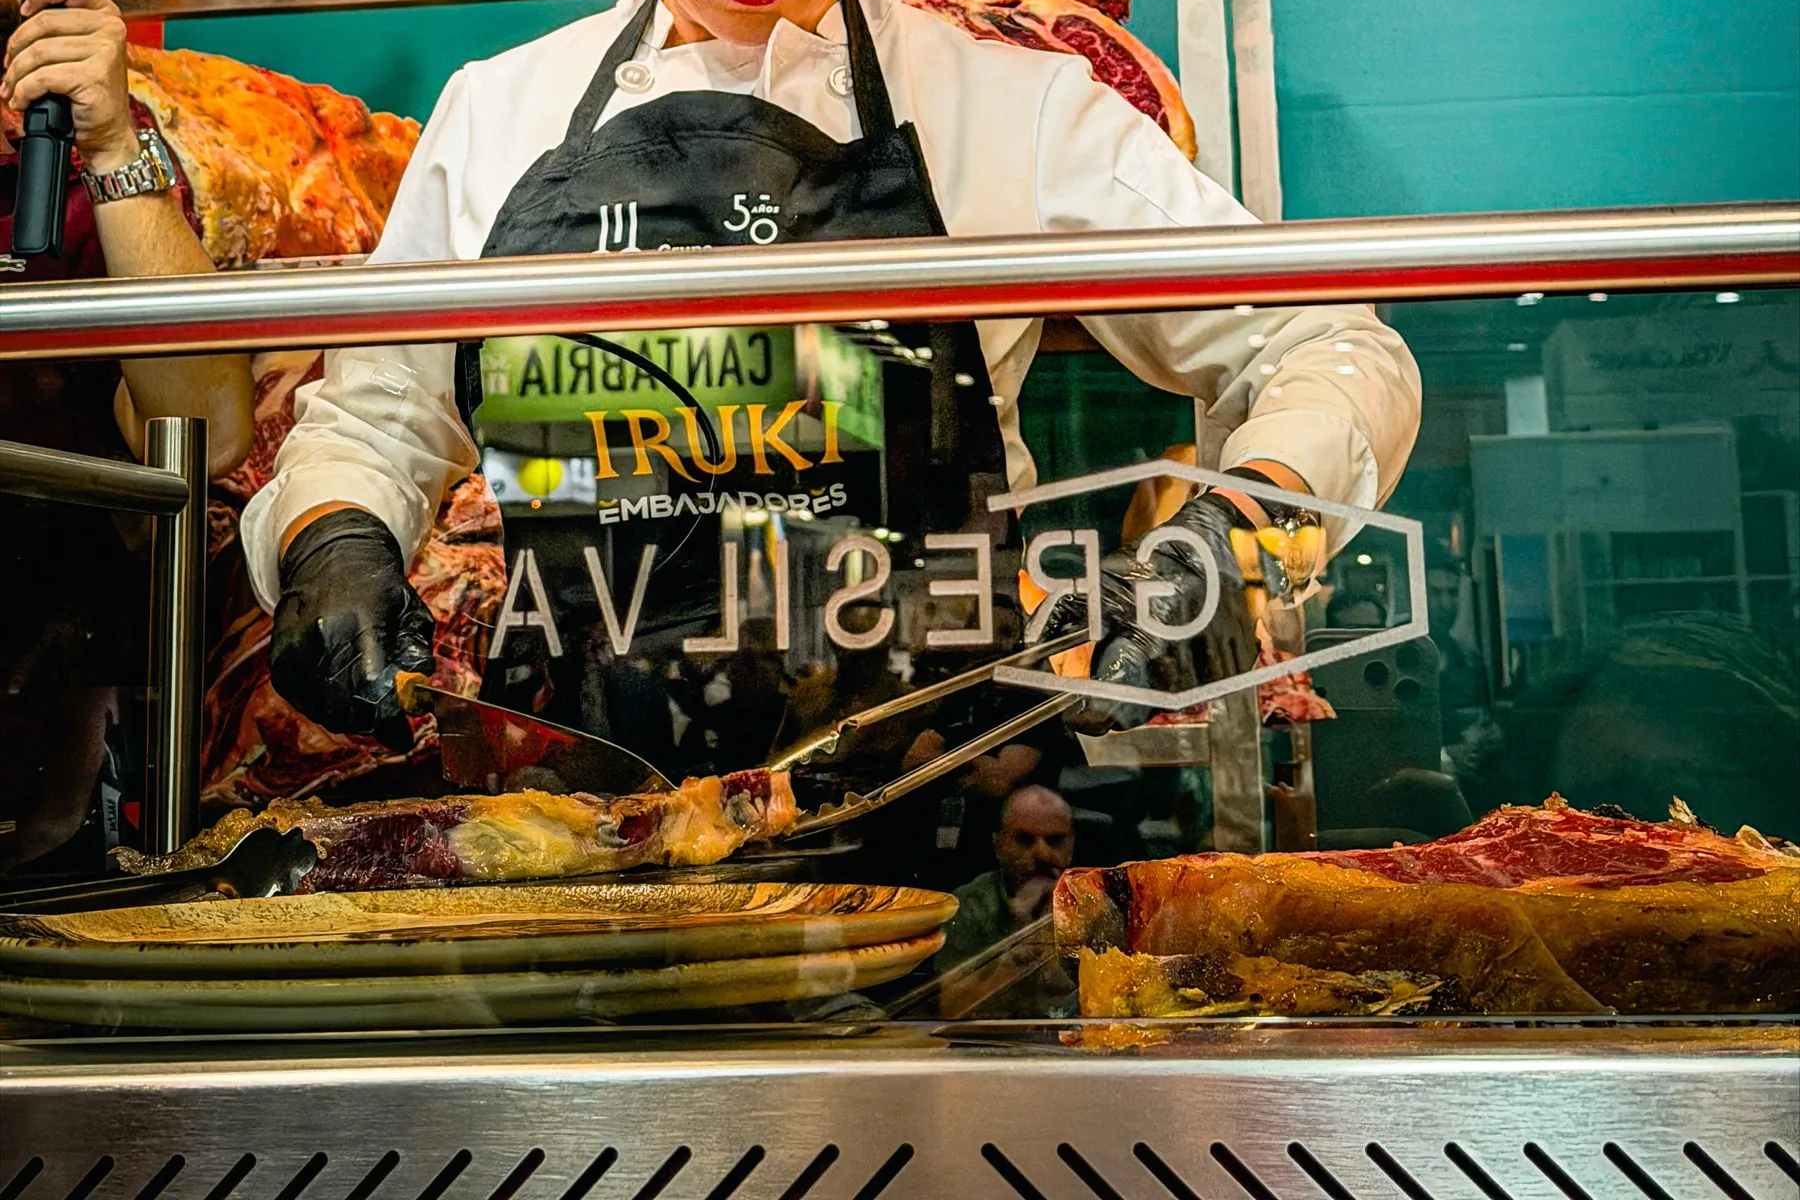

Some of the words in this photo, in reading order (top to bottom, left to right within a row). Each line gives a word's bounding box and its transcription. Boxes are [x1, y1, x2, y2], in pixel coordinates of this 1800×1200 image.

[750, 203, 780, 215] AÑOS
[584, 399, 845, 483] IRUKI
[599, 482, 848, 525] EMBAJADORES
